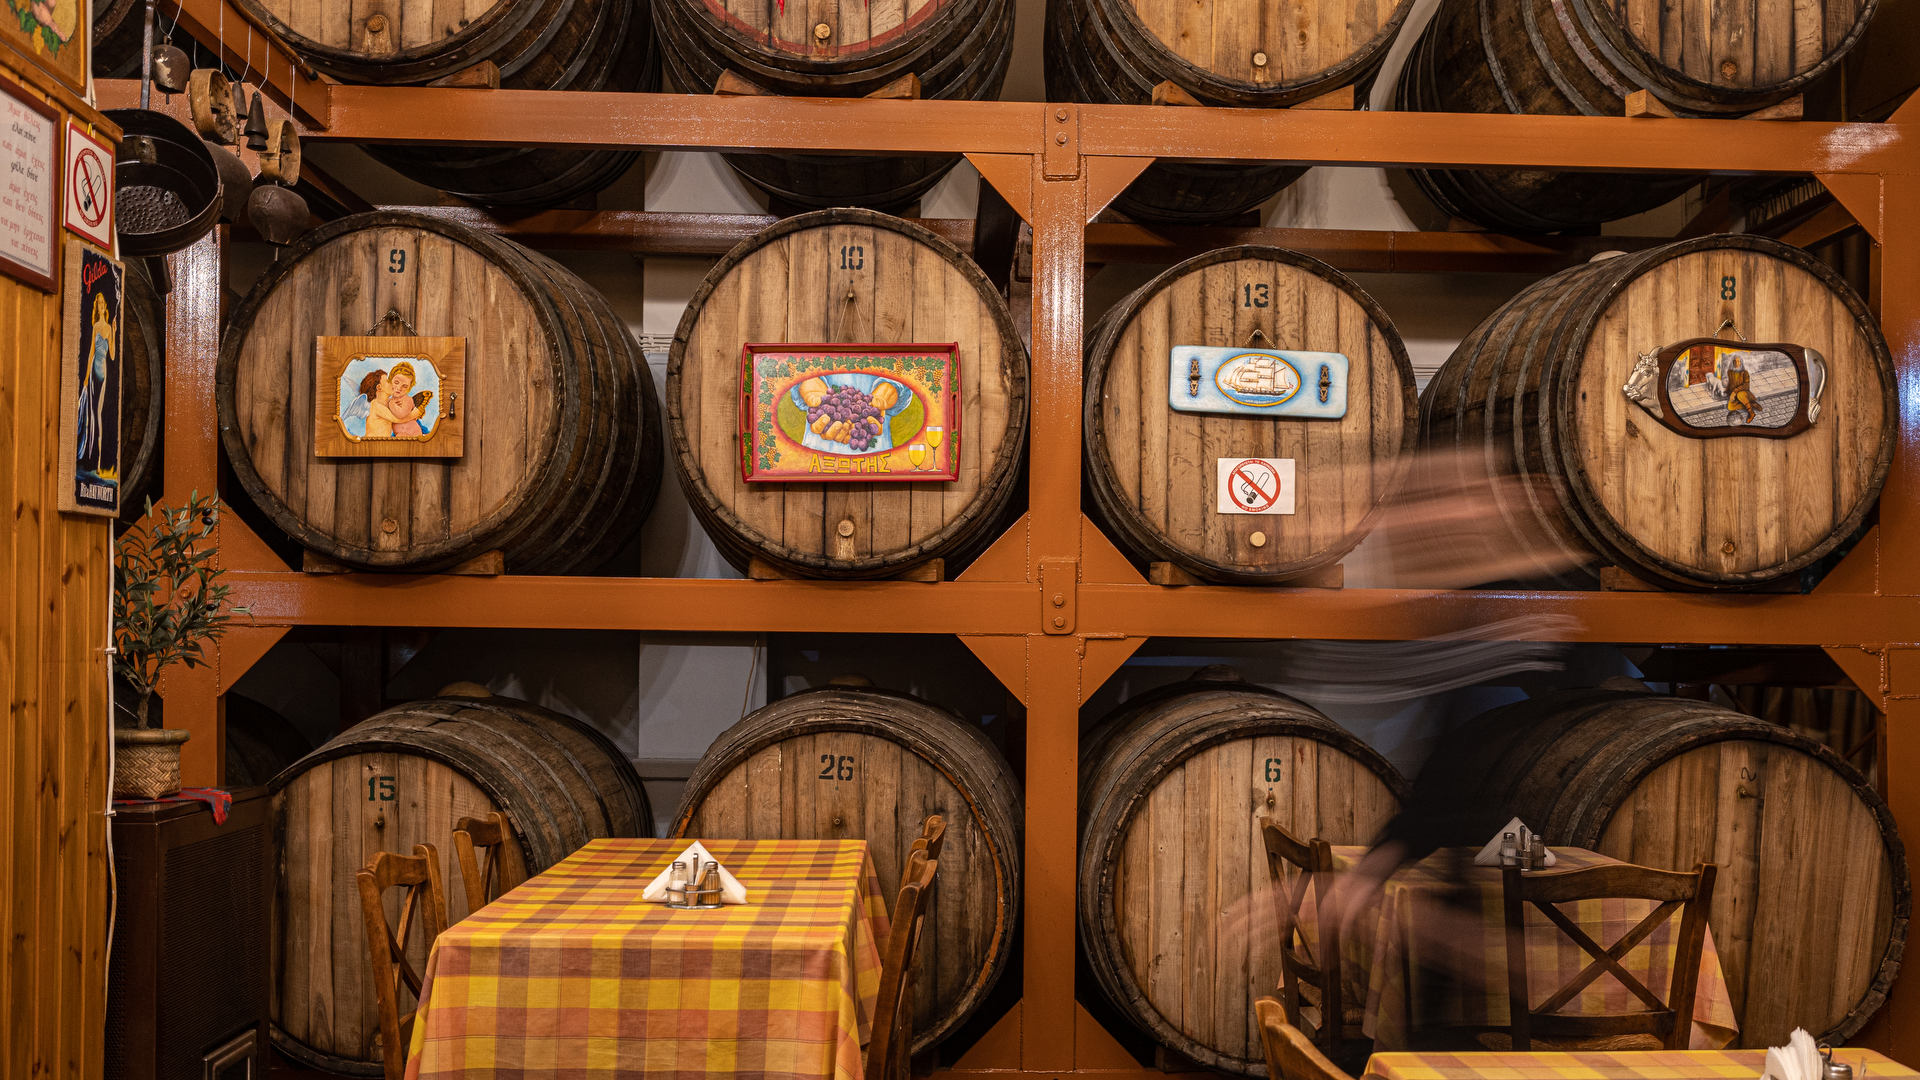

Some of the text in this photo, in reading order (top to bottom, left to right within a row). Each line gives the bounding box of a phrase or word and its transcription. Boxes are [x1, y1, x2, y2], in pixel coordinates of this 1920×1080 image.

[389, 249, 406, 273] 9
[840, 245, 864, 270] 10
[83, 260, 108, 295] Gilda
[1720, 276, 1736, 301] 8
[1244, 283, 1269, 308] 13
[808, 452, 892, 474] ΑΞΩΤΗΣ
[818, 754, 855, 781] 26
[1265, 758, 1281, 783] 6
[368, 776, 395, 802] 15
